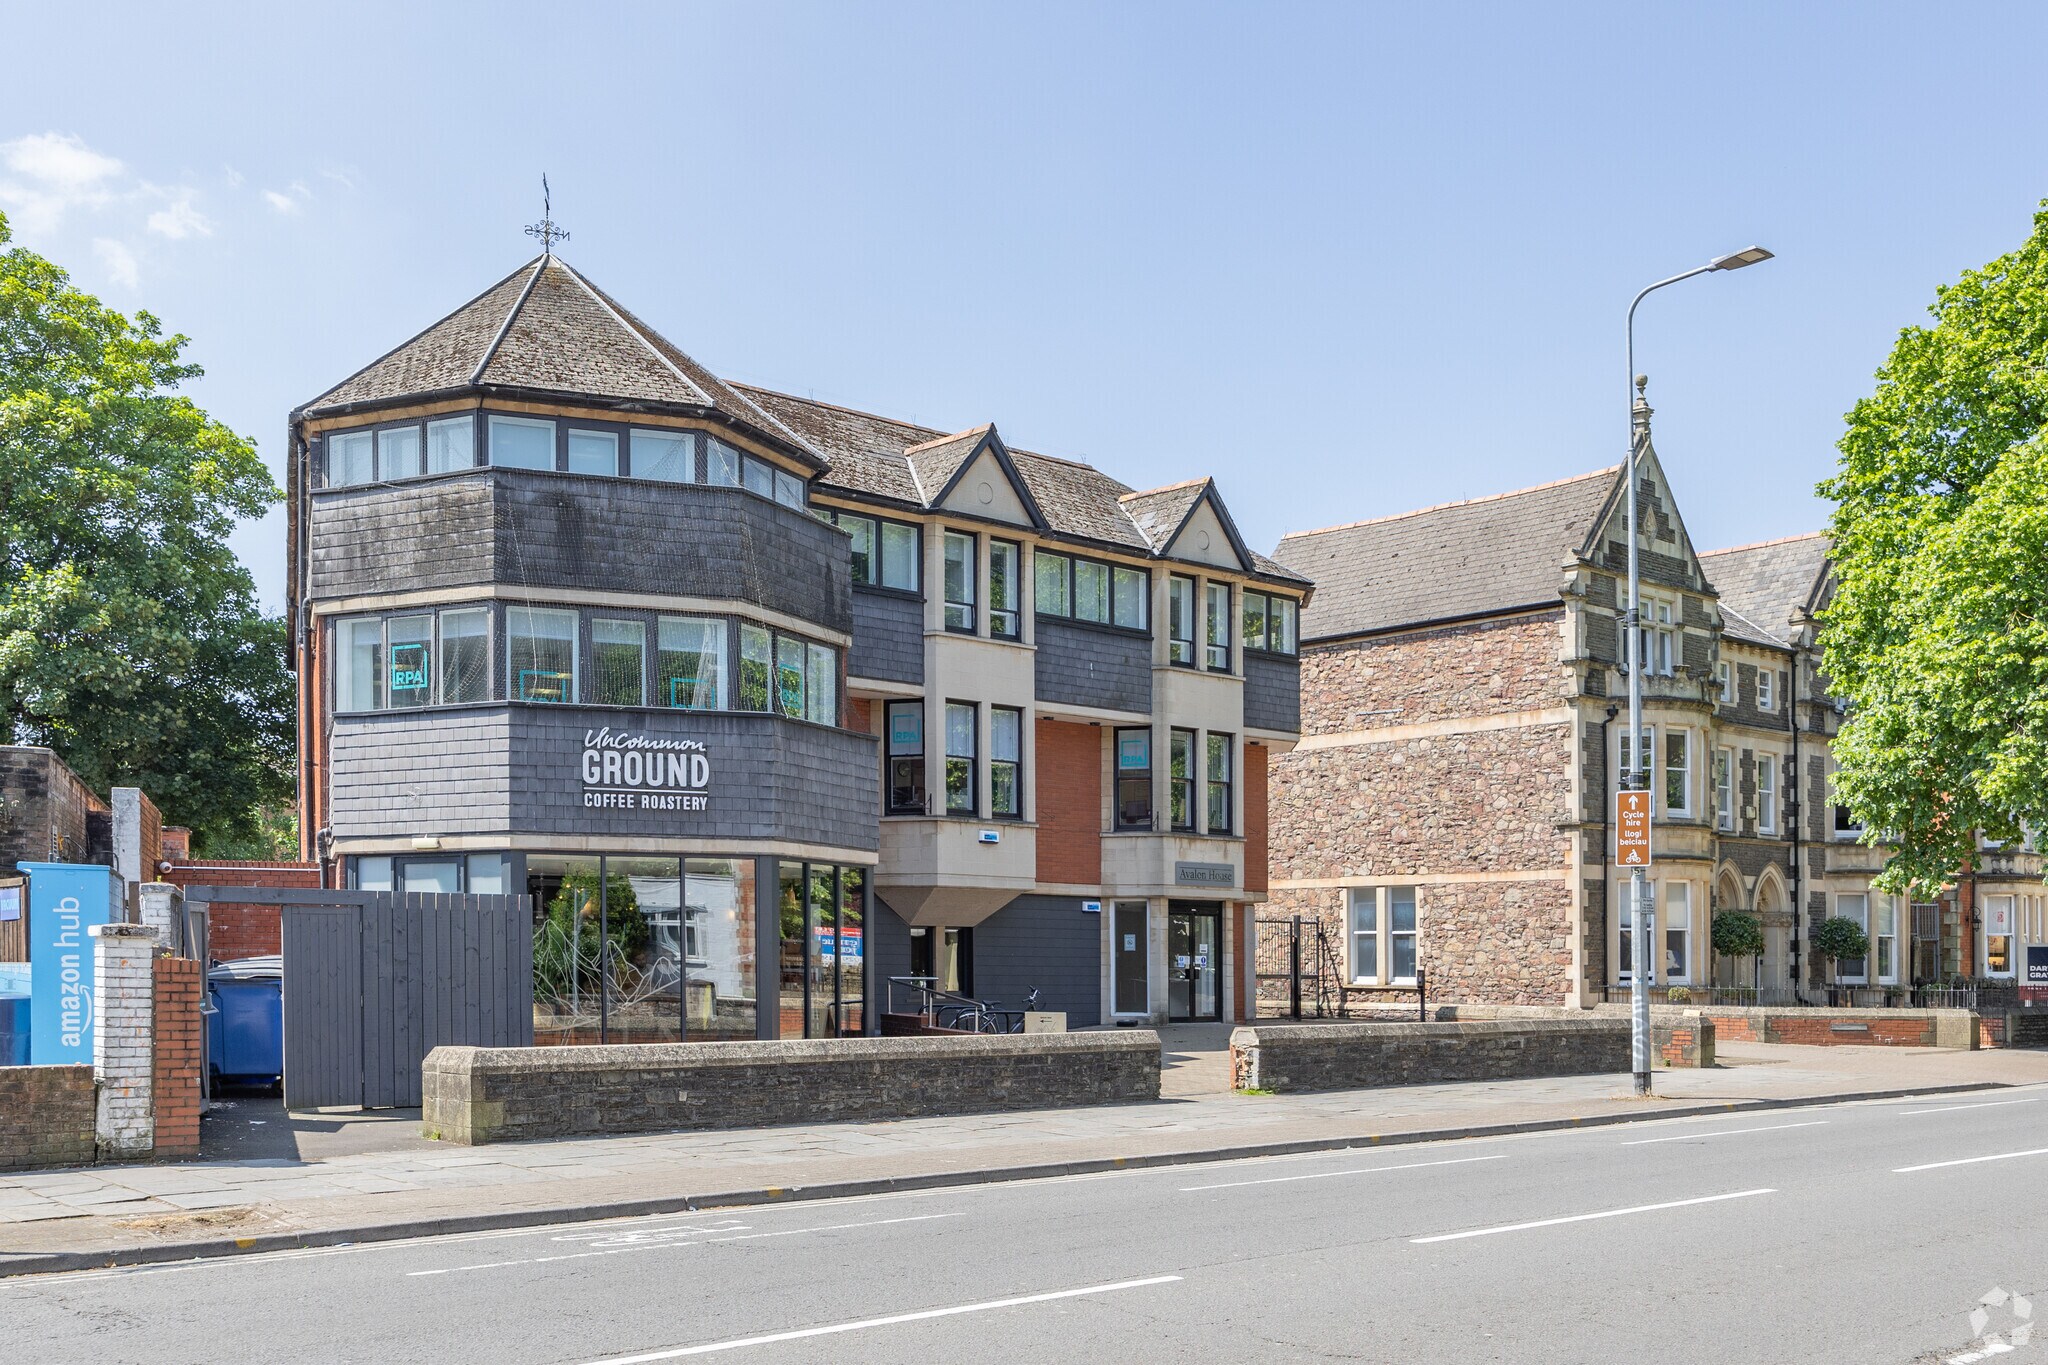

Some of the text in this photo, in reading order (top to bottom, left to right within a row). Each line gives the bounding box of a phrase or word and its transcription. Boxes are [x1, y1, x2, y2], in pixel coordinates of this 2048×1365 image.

[395, 670, 424, 685] RPA
[895, 731, 917, 740] RPA
[582, 749, 710, 788] GROUND
[584, 792, 708, 811] COFFEE ROASTERY
[1622, 811, 1645, 819] Cycle
[1626, 819, 1641, 827] hire
[1624, 830, 1642, 838] llogi
[1619, 838, 1647, 846] beiciau
[1180, 868, 1233, 881] Avalon House
[53, 896, 81, 1047] amazon hub
[2029, 971, 2048, 979] GRA
